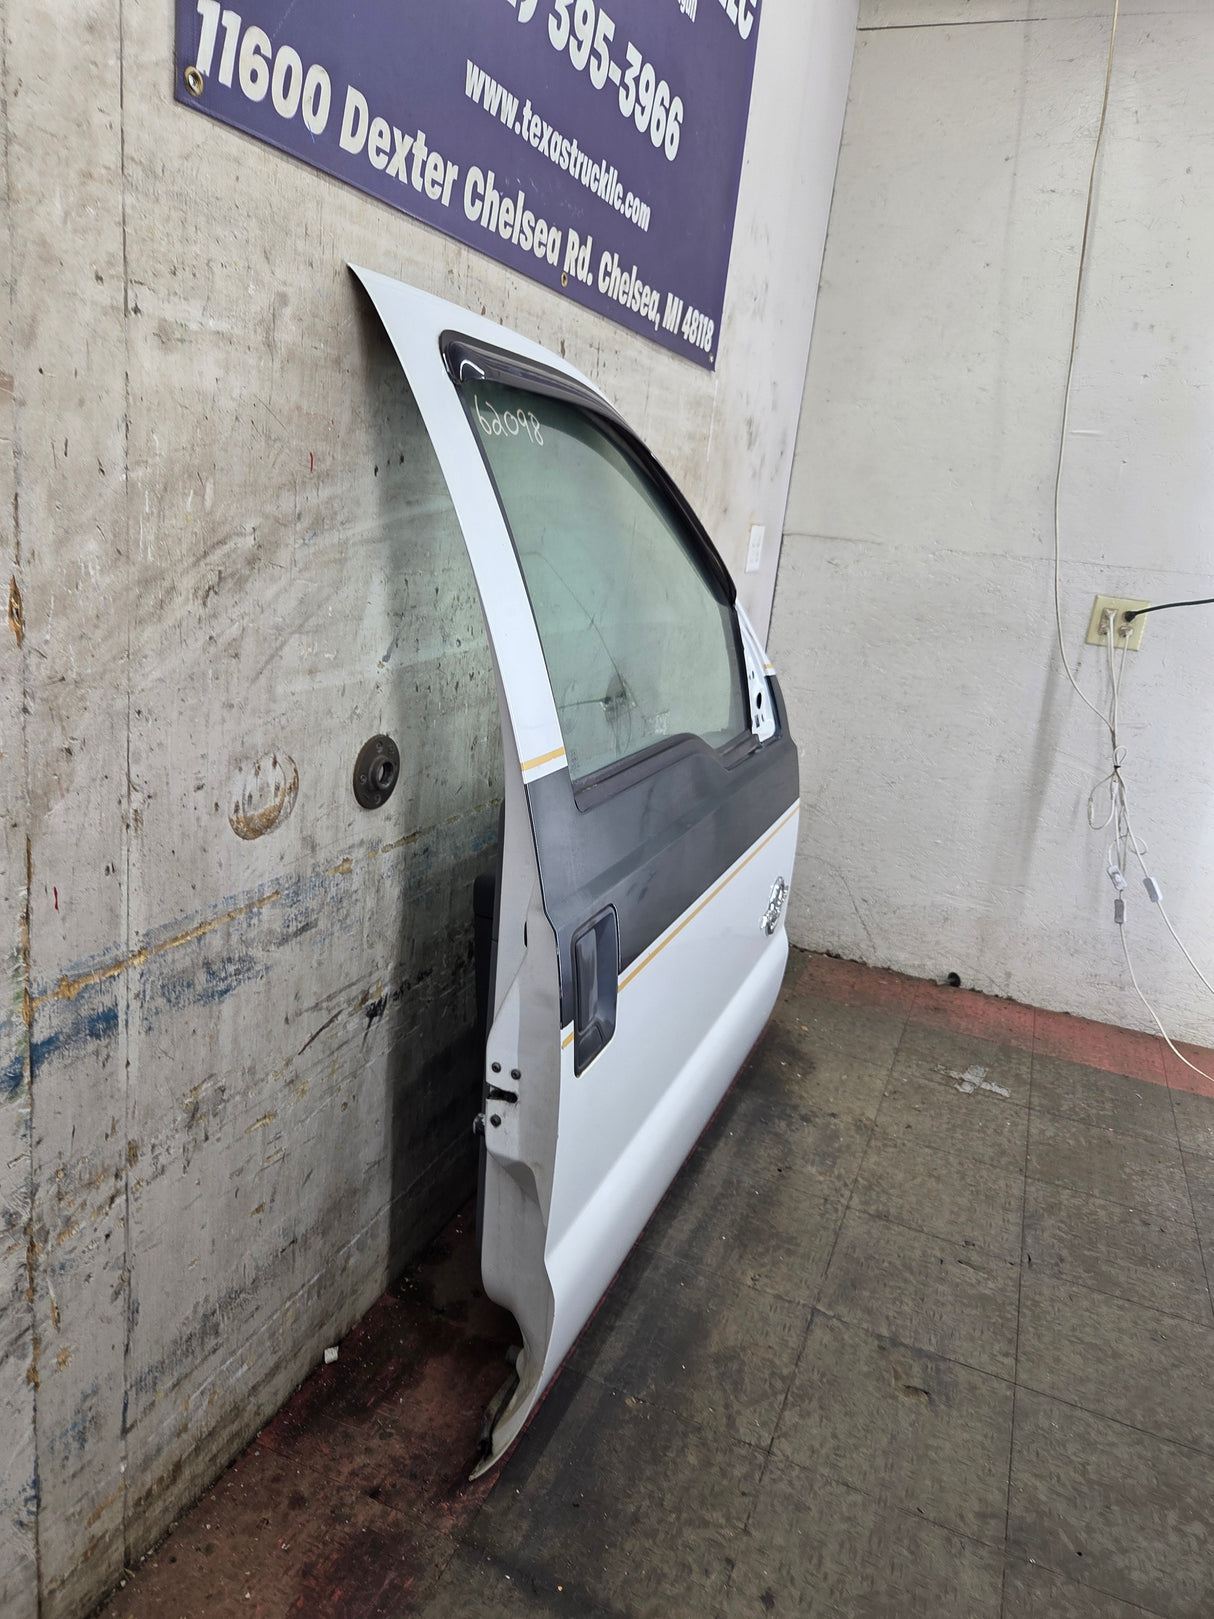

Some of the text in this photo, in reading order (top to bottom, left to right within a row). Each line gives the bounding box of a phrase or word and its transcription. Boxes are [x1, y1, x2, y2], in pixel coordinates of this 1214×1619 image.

[465, 59, 651, 233] www.texastruckllc.com
[547, 0, 684, 161] 395-3966
[195, 0, 715, 353] 11600 Dexter Chelsea Rd. Chelsea, MI 48118
[474, 394, 544, 446] 62098
